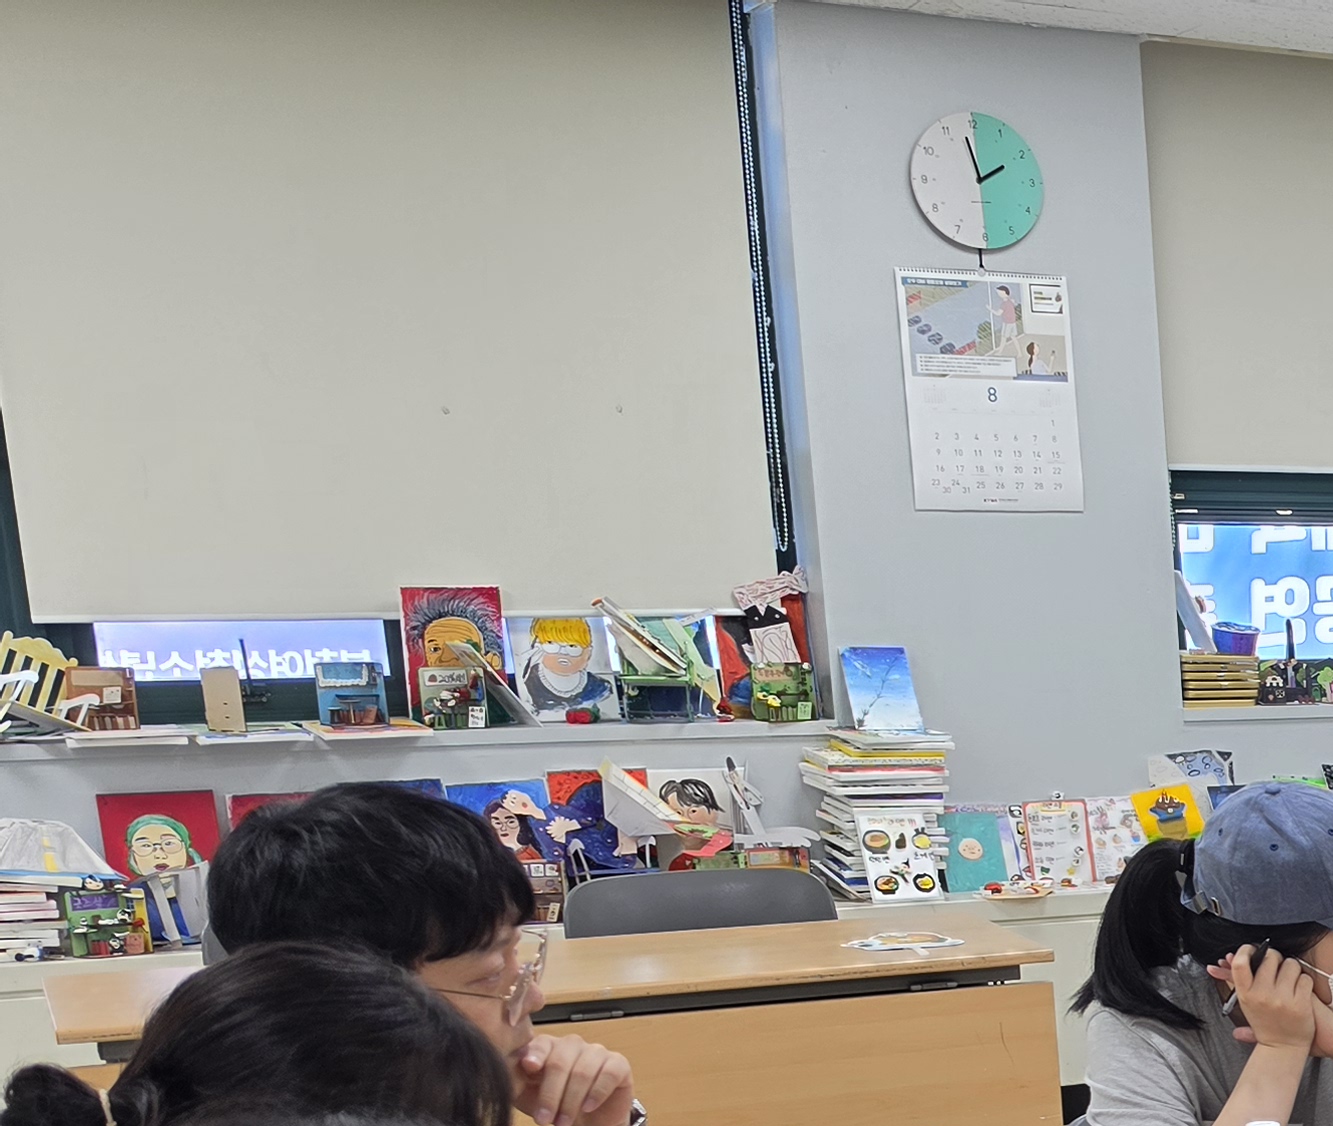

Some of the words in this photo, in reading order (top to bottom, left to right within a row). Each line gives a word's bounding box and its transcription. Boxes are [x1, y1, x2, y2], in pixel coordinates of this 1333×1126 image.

[968, 119, 978, 130] 12
[942, 126, 951, 136] 11
[998, 129, 1002, 138] 1
[923, 146, 935, 156] 10
[1019, 150, 1026, 160] 2
[921, 175, 928, 184] 9
[1029, 179, 1036, 188] 3
[932, 203, 939, 213] 8
[1025, 206, 1031, 215] 4
[955, 224, 961, 234] 7
[1009, 226, 1015, 236] 5
[983, 232, 989, 242] 6
[987, 387, 998, 403] 8
[1051, 419, 1056, 428] 1
[934, 433, 940, 441] 2
[954, 433, 960, 441] 3
[974, 433, 980, 442] 4
[993, 434, 999, 442] 5
[1013, 435, 1019, 443] 6
[1033, 435, 1038, 443] 7
[1051, 435, 1058, 443] 8
[936, 449, 942, 457] 9
[954, 449, 964, 457] 10
[974, 449, 983, 457] 11
[993, 450, 1003, 458] 12
[1013, 450, 1022, 459] 13
[1032, 451, 1042, 459] 14
[1051, 451, 1061, 459] 15
[935, 465, 945, 473] 16
[955, 465, 965, 473] 17
[975, 465, 985, 473] 18
[995, 466, 1004, 474] 19
[1014, 466, 1024, 474] 20
[1033, 467, 1043, 475] 21
[1052, 467, 1062, 475] 22
[931, 479, 941, 487] 23
[951, 479, 961, 487] 24
[976, 481, 986, 489] 25
[996, 482, 1006, 490] 26
[1015, 482, 1025, 490] 27
[1034, 482, 1044, 491] 28
[1053, 483, 1063, 491] 29
[942, 486, 952, 494] 30
[962, 486, 971, 494] 31
